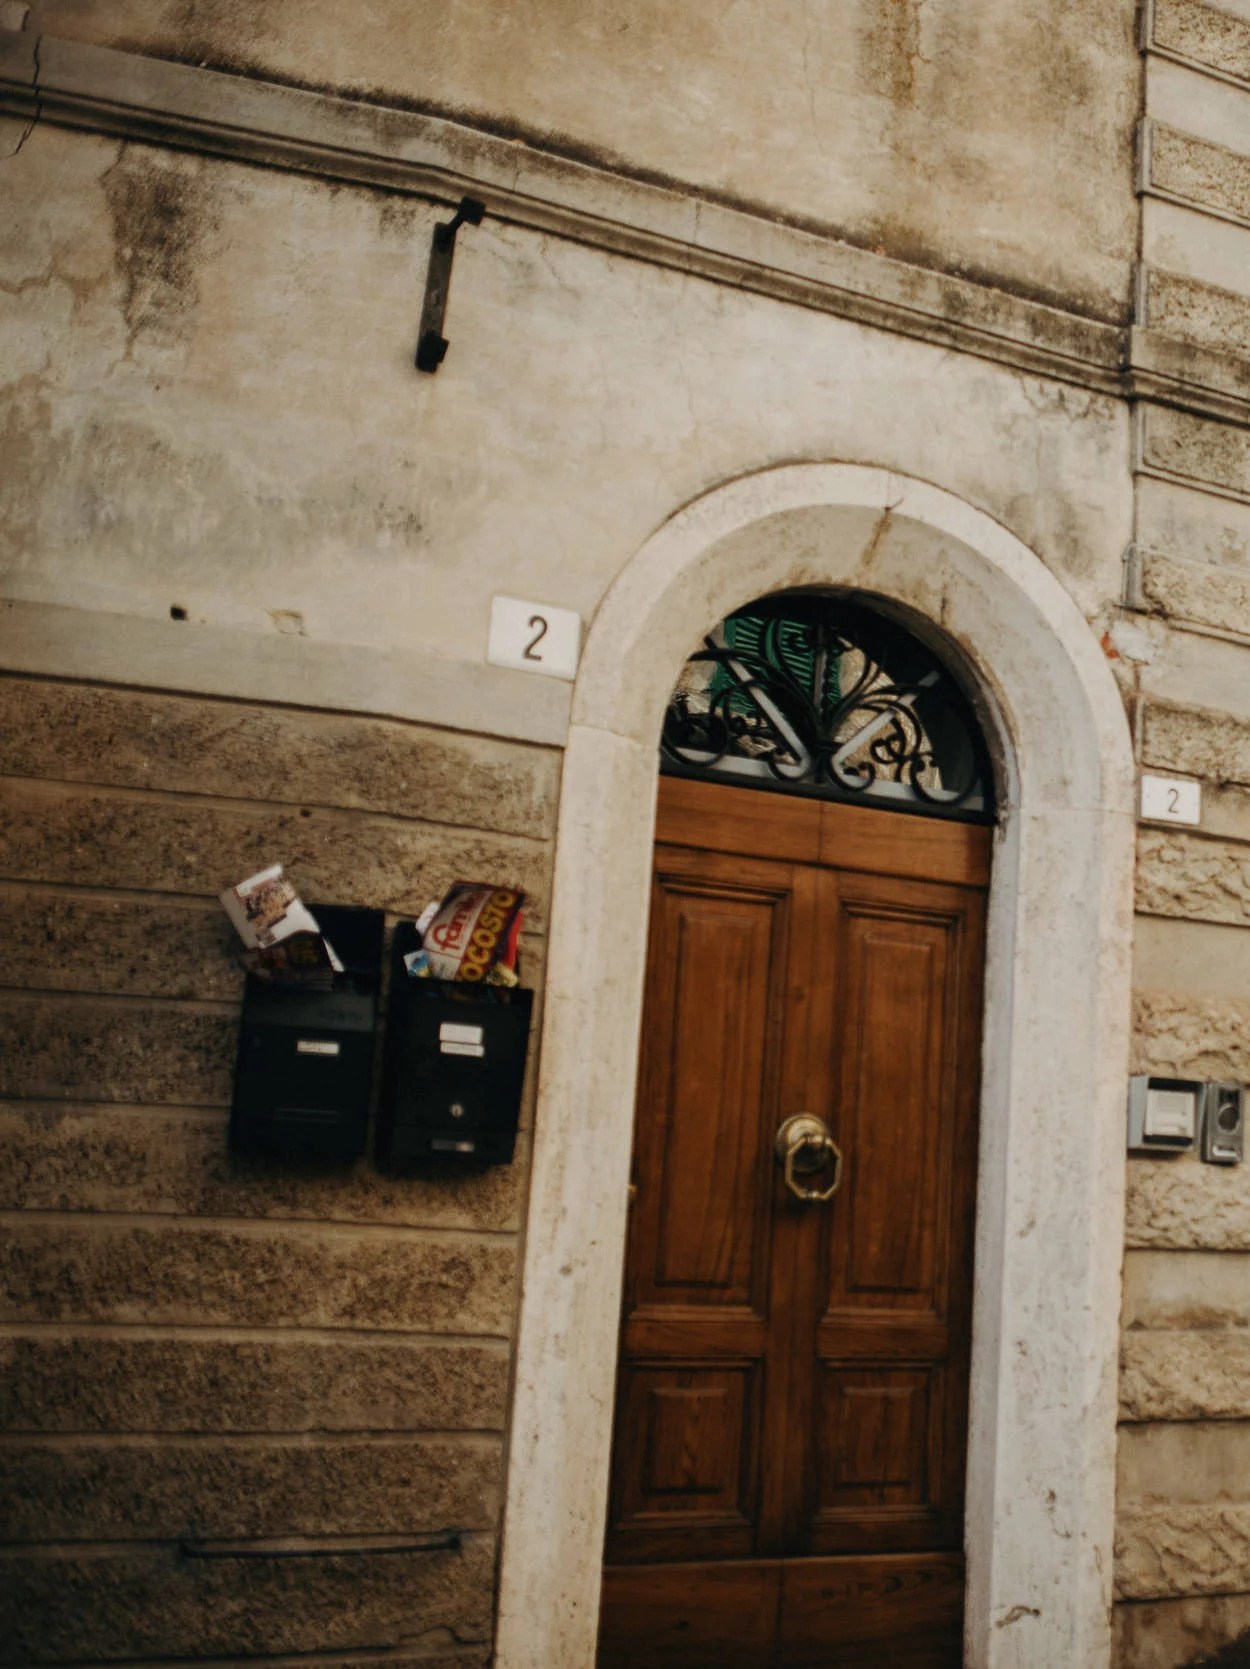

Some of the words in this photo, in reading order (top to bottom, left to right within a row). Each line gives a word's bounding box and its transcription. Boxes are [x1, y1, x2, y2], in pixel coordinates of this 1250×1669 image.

[522, 614, 548, 662] 2
[1167, 788, 1180, 815] 2
[455, 891, 516, 982] OCOSTO
